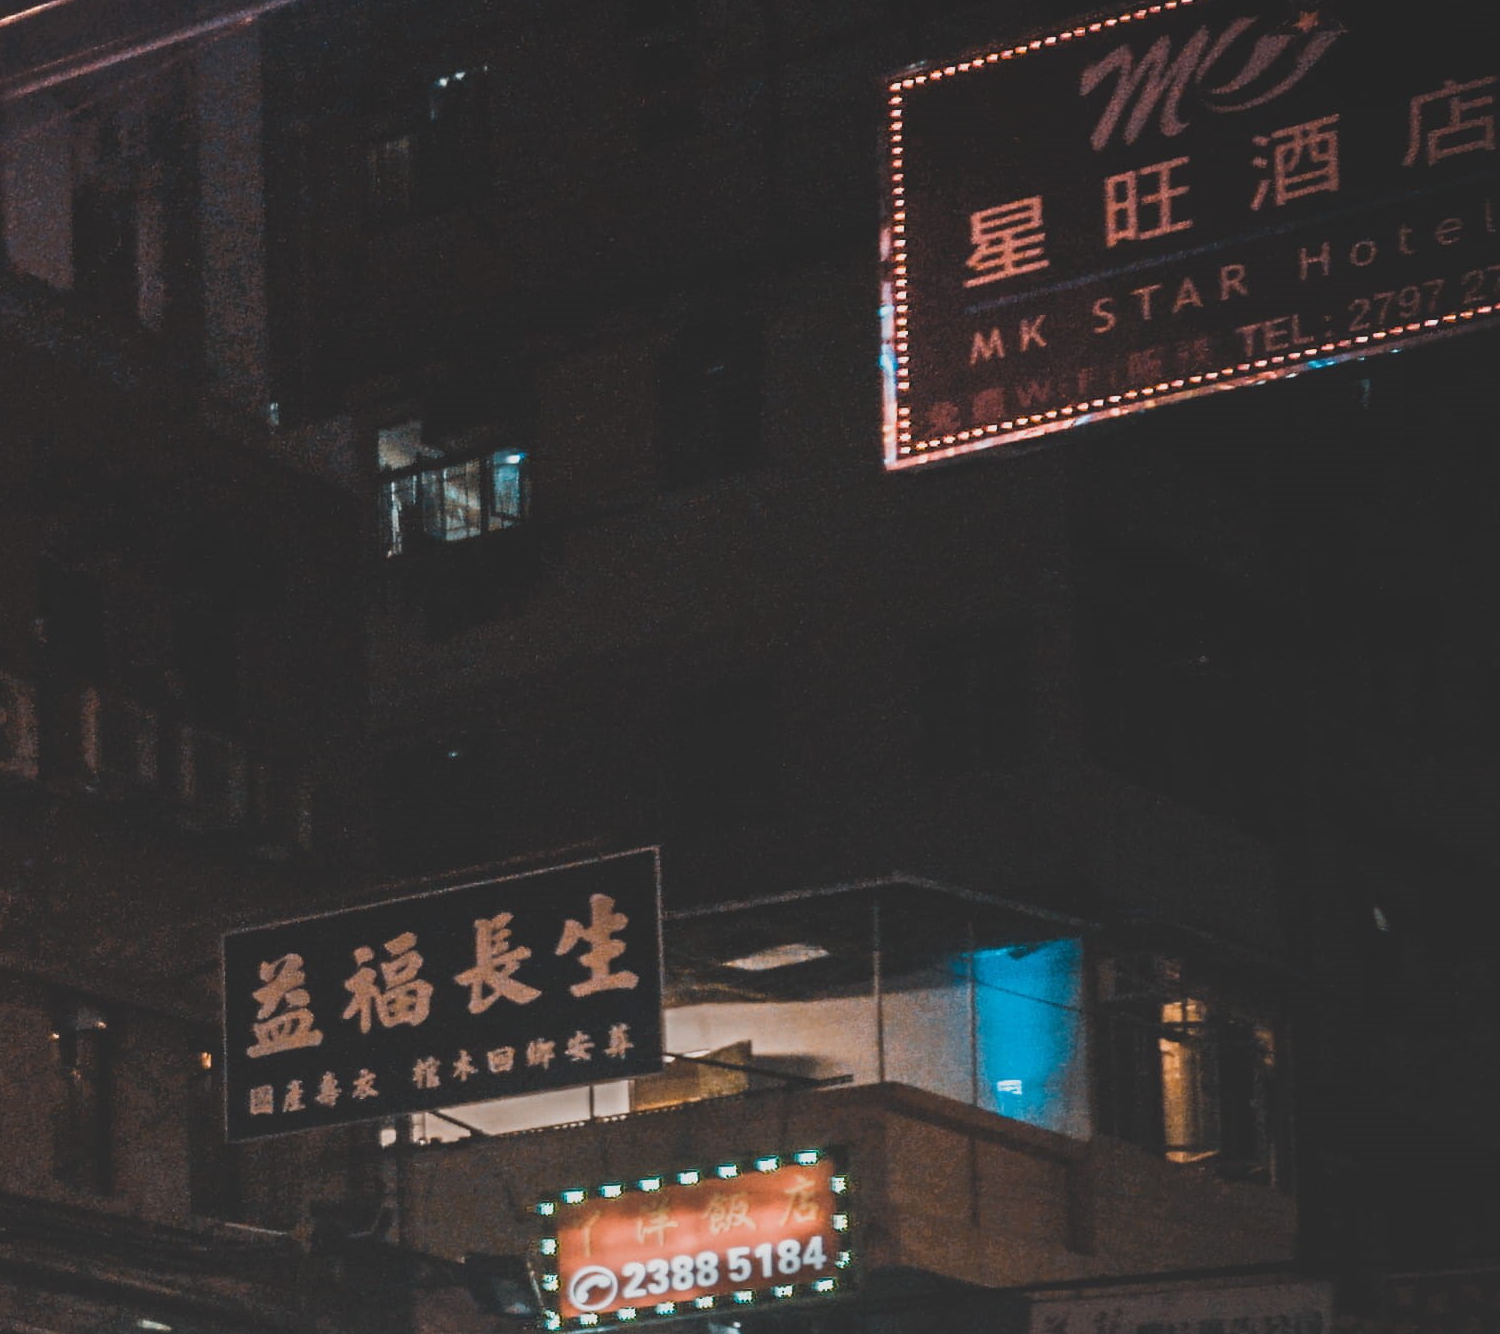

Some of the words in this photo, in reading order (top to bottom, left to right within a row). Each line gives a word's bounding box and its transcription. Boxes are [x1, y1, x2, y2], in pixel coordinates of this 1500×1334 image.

[963, 75, 1500, 289] 星旺酒店
[969, 314, 1047, 365] MK
[1091, 265, 1249, 335] STAR
[1297, 196, 1499, 282] Hotel
[621, 1250, 719, 1299] 2388
[727, 1235, 827, 1283] 5184
